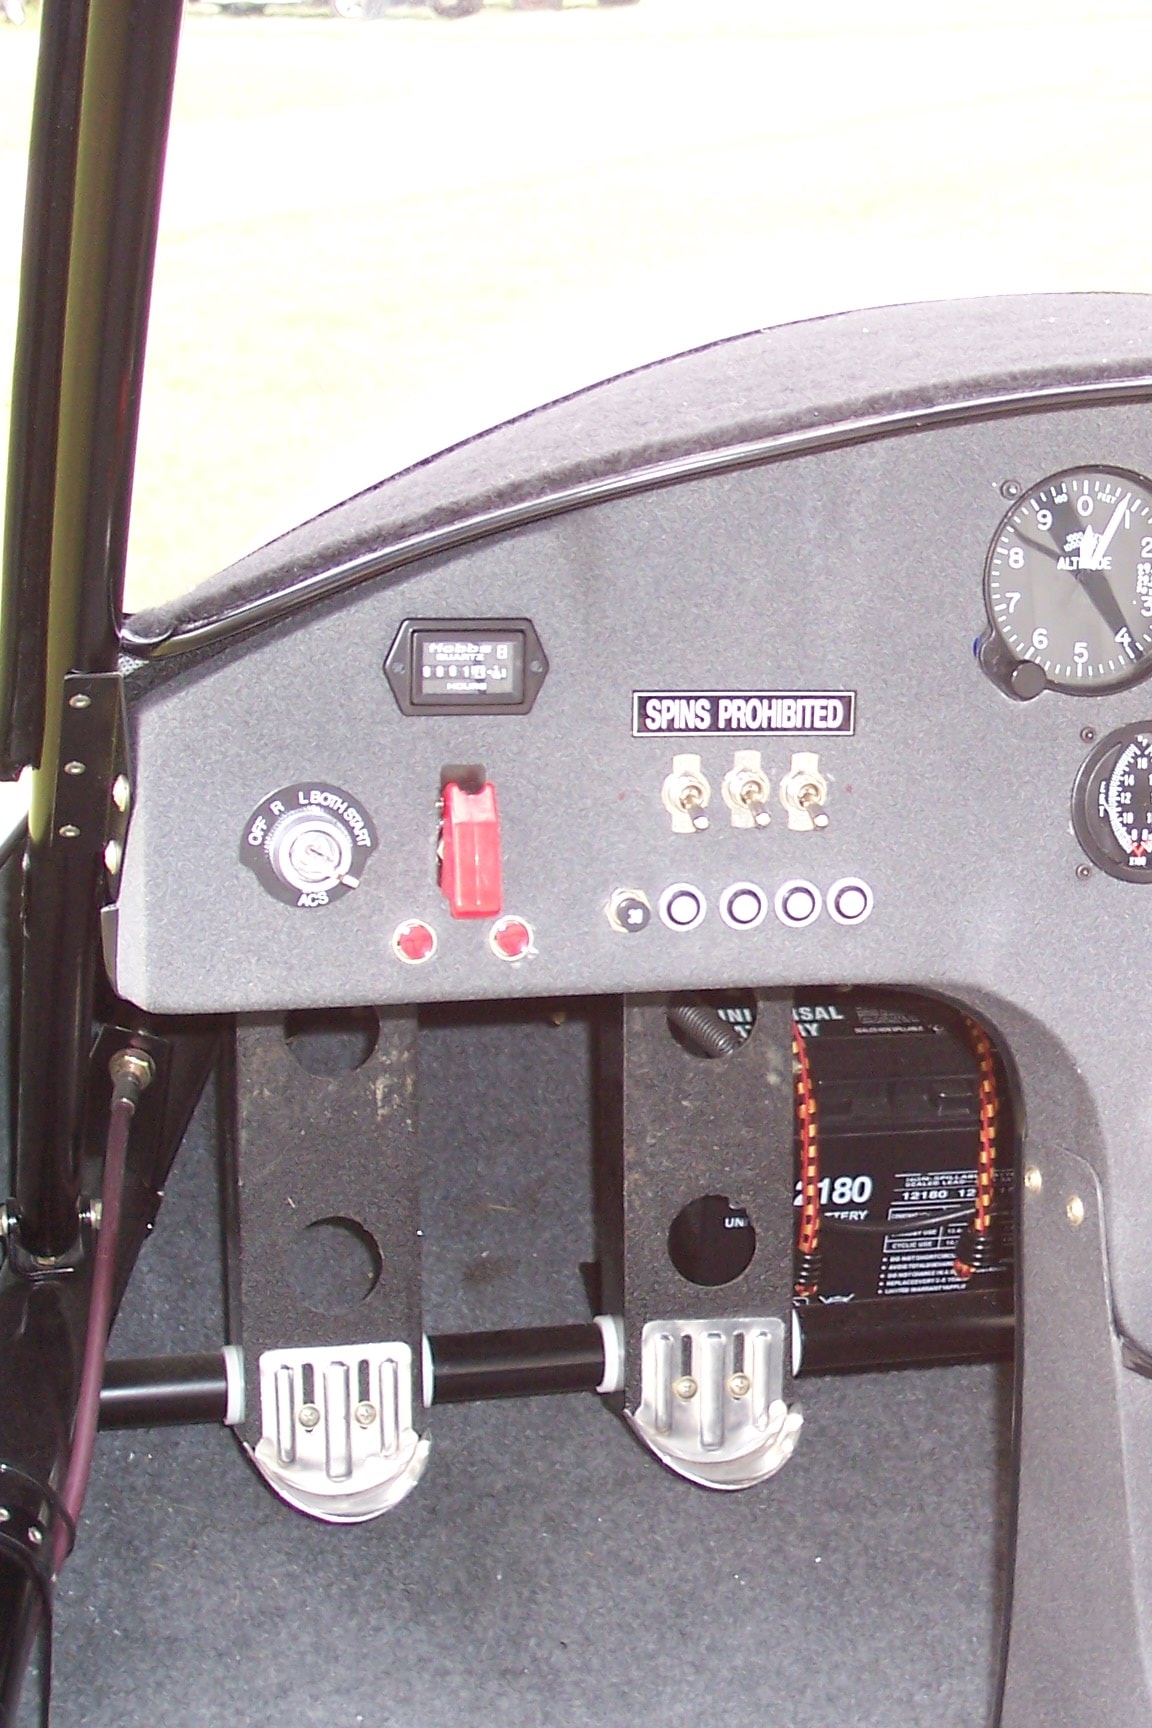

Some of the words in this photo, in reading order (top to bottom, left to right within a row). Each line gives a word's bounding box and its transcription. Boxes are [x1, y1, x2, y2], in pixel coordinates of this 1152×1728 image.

[1077, 495, 1093, 517] 0
[1036, 509, 1053, 531] 9
[1009, 547, 1024, 569] 8
[1057, 557, 1112, 570] ALTDE
[1005, 592, 1021, 613] 7
[428, 642, 492, 654] Hobbs
[1032, 628, 1048, 650] 6
[1115, 626, 1132, 649] 4
[1073, 642, 1088, 663] 5
[447, 682, 488, 691] HOURS
[645, 698, 711, 731] SPINS
[718, 698, 844, 729] PROHIBITED
[270, 800, 285, 816] R
[1120, 792, 1132, 804] 12
[298, 791, 309, 805] L
[310, 790, 348, 814] BOTH
[343, 807, 371, 847] START
[248, 816, 267, 846] OFF
[297, 891, 329, 908] ACS
[902, 1190, 948, 1200] 12180
